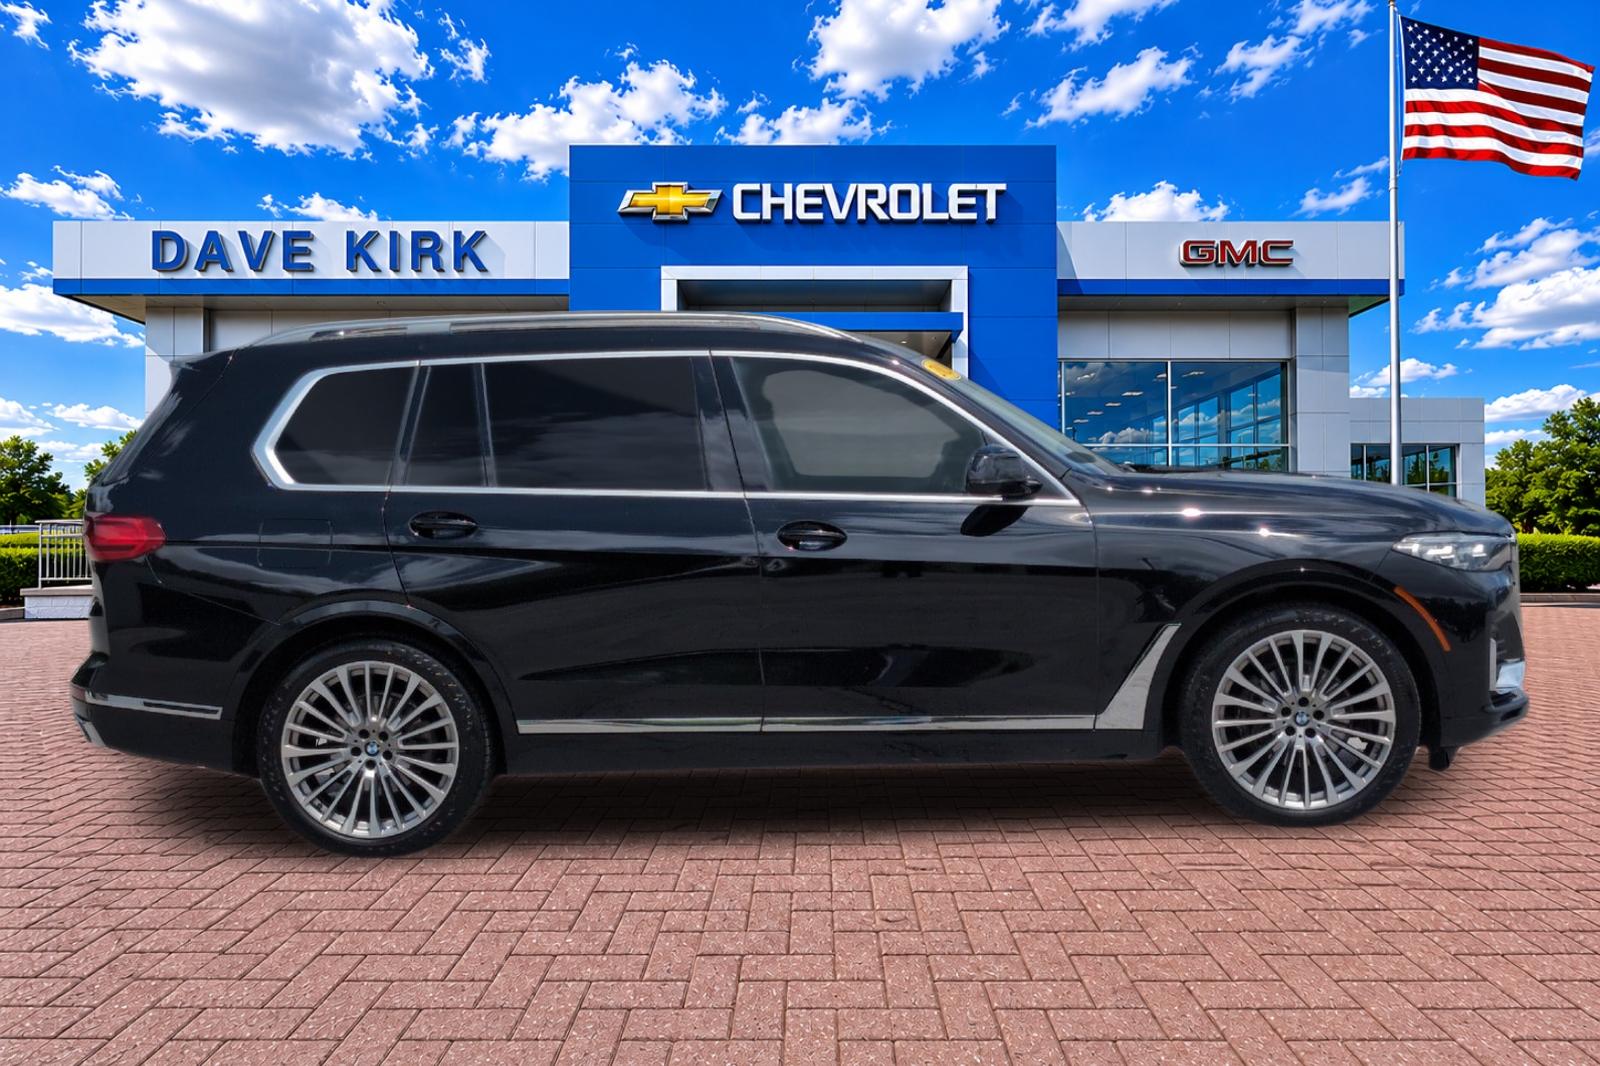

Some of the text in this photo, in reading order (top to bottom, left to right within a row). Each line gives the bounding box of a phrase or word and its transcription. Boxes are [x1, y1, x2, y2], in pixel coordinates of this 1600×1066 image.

[732, 183, 1007, 223] CHEVROLET
[152, 230, 488, 272] DAVE KIRK
[1180, 239, 1294, 266] GMC
